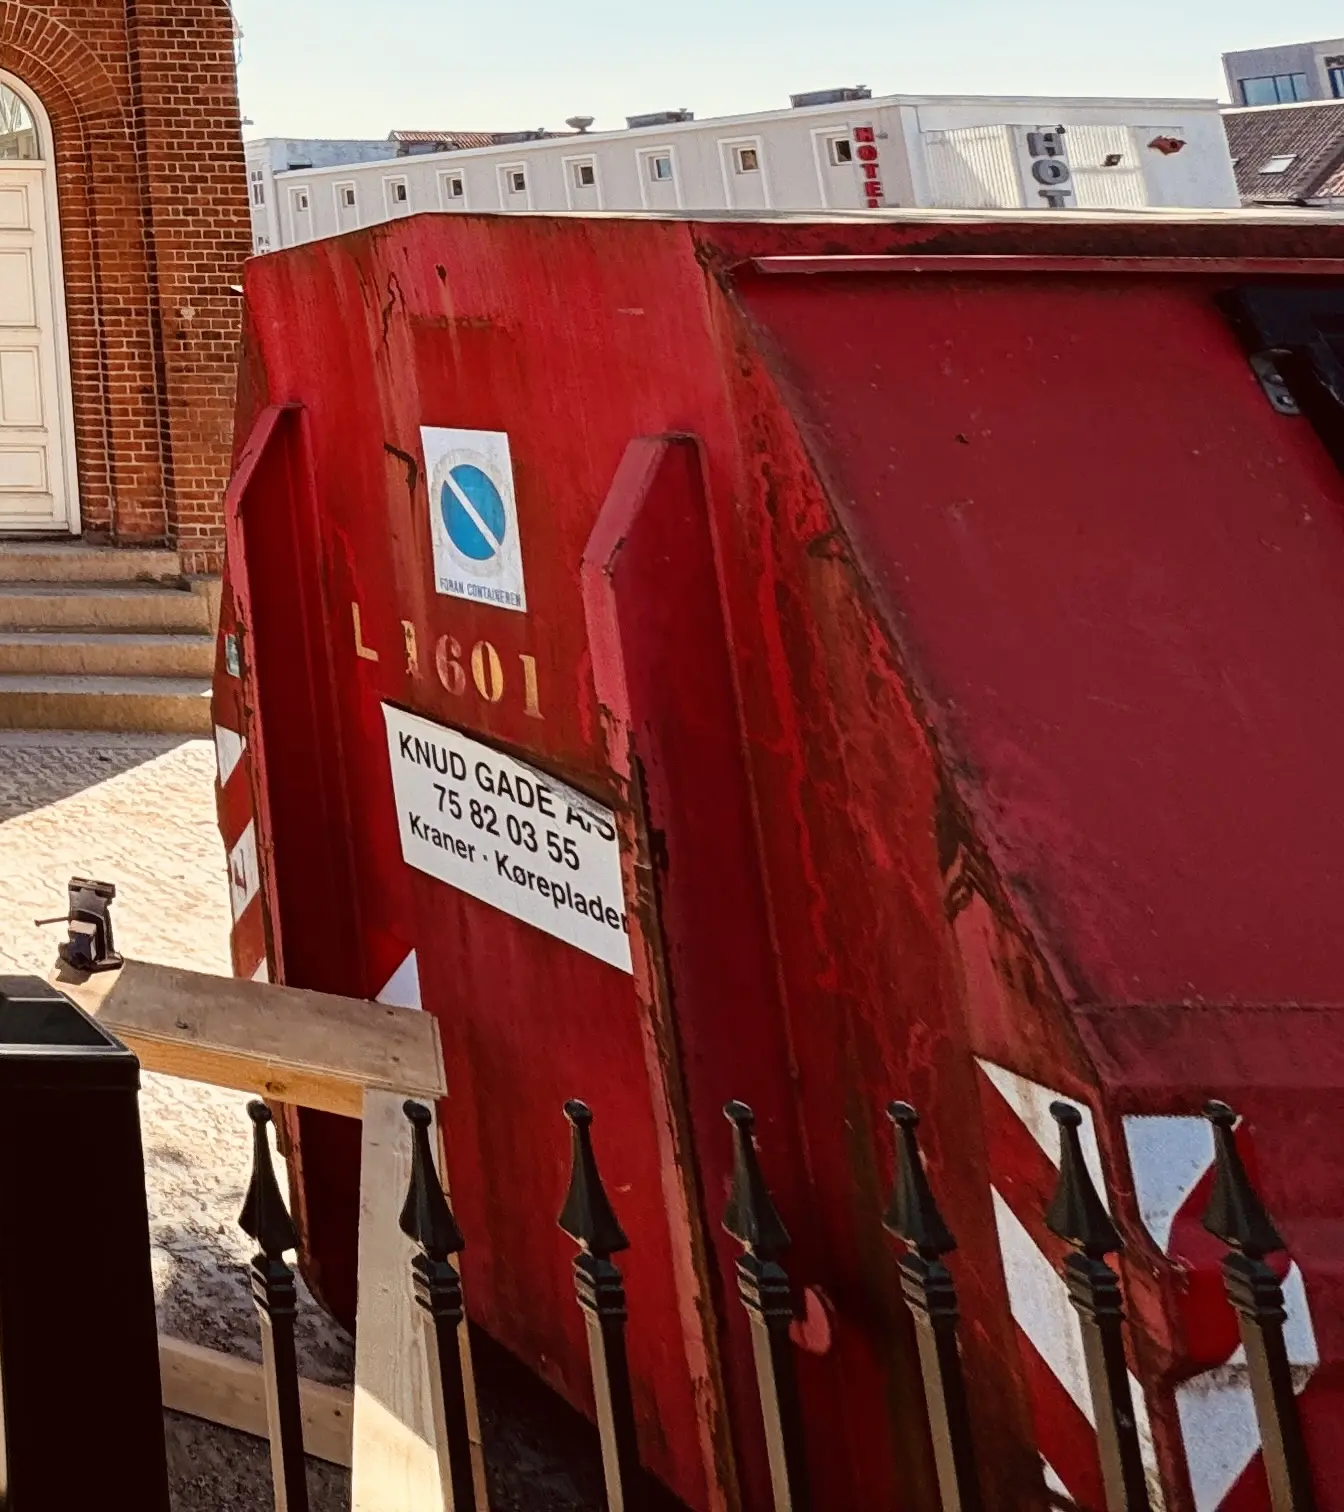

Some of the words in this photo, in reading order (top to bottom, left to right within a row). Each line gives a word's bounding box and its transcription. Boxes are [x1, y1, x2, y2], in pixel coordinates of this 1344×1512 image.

[351, 601, 379, 662] L
[401, 620, 545, 720] 1601
[398, 731, 466, 781] KNUD
[475, 761, 556, 819] GADE
[408, 811, 476, 863] Kraner
[433, 783, 462, 820] 75
[469, 798, 500, 837] 82
[506, 814, 538, 853] 03
[546, 830, 580, 870] 55
